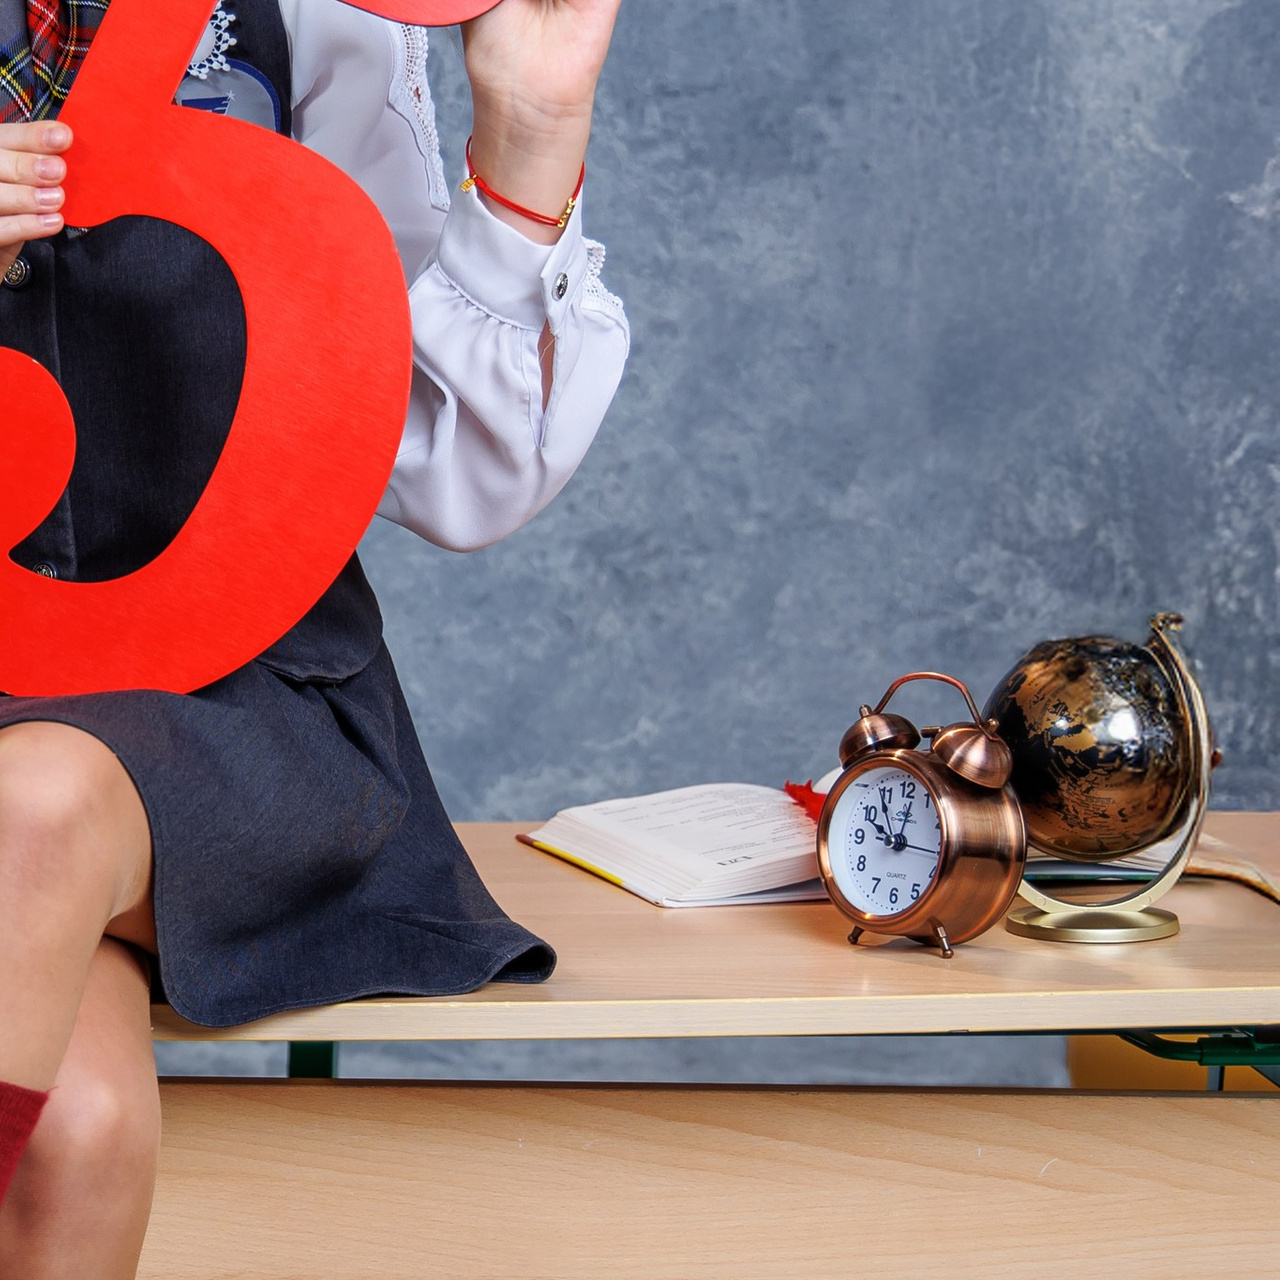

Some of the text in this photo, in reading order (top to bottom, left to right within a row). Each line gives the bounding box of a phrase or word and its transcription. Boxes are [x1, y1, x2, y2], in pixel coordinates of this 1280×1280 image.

[880, 786, 893, 804] 11
[900, 781, 916, 799] 12
[863, 805, 877, 822] 10
[854, 828, 865, 845] 9
[856, 855, 867, 872] 8
[886, 871, 907, 880] QUARTZ
[871, 877, 881, 894] 7
[910, 883, 921, 900] 5
[889, 887, 899, 904] 6
